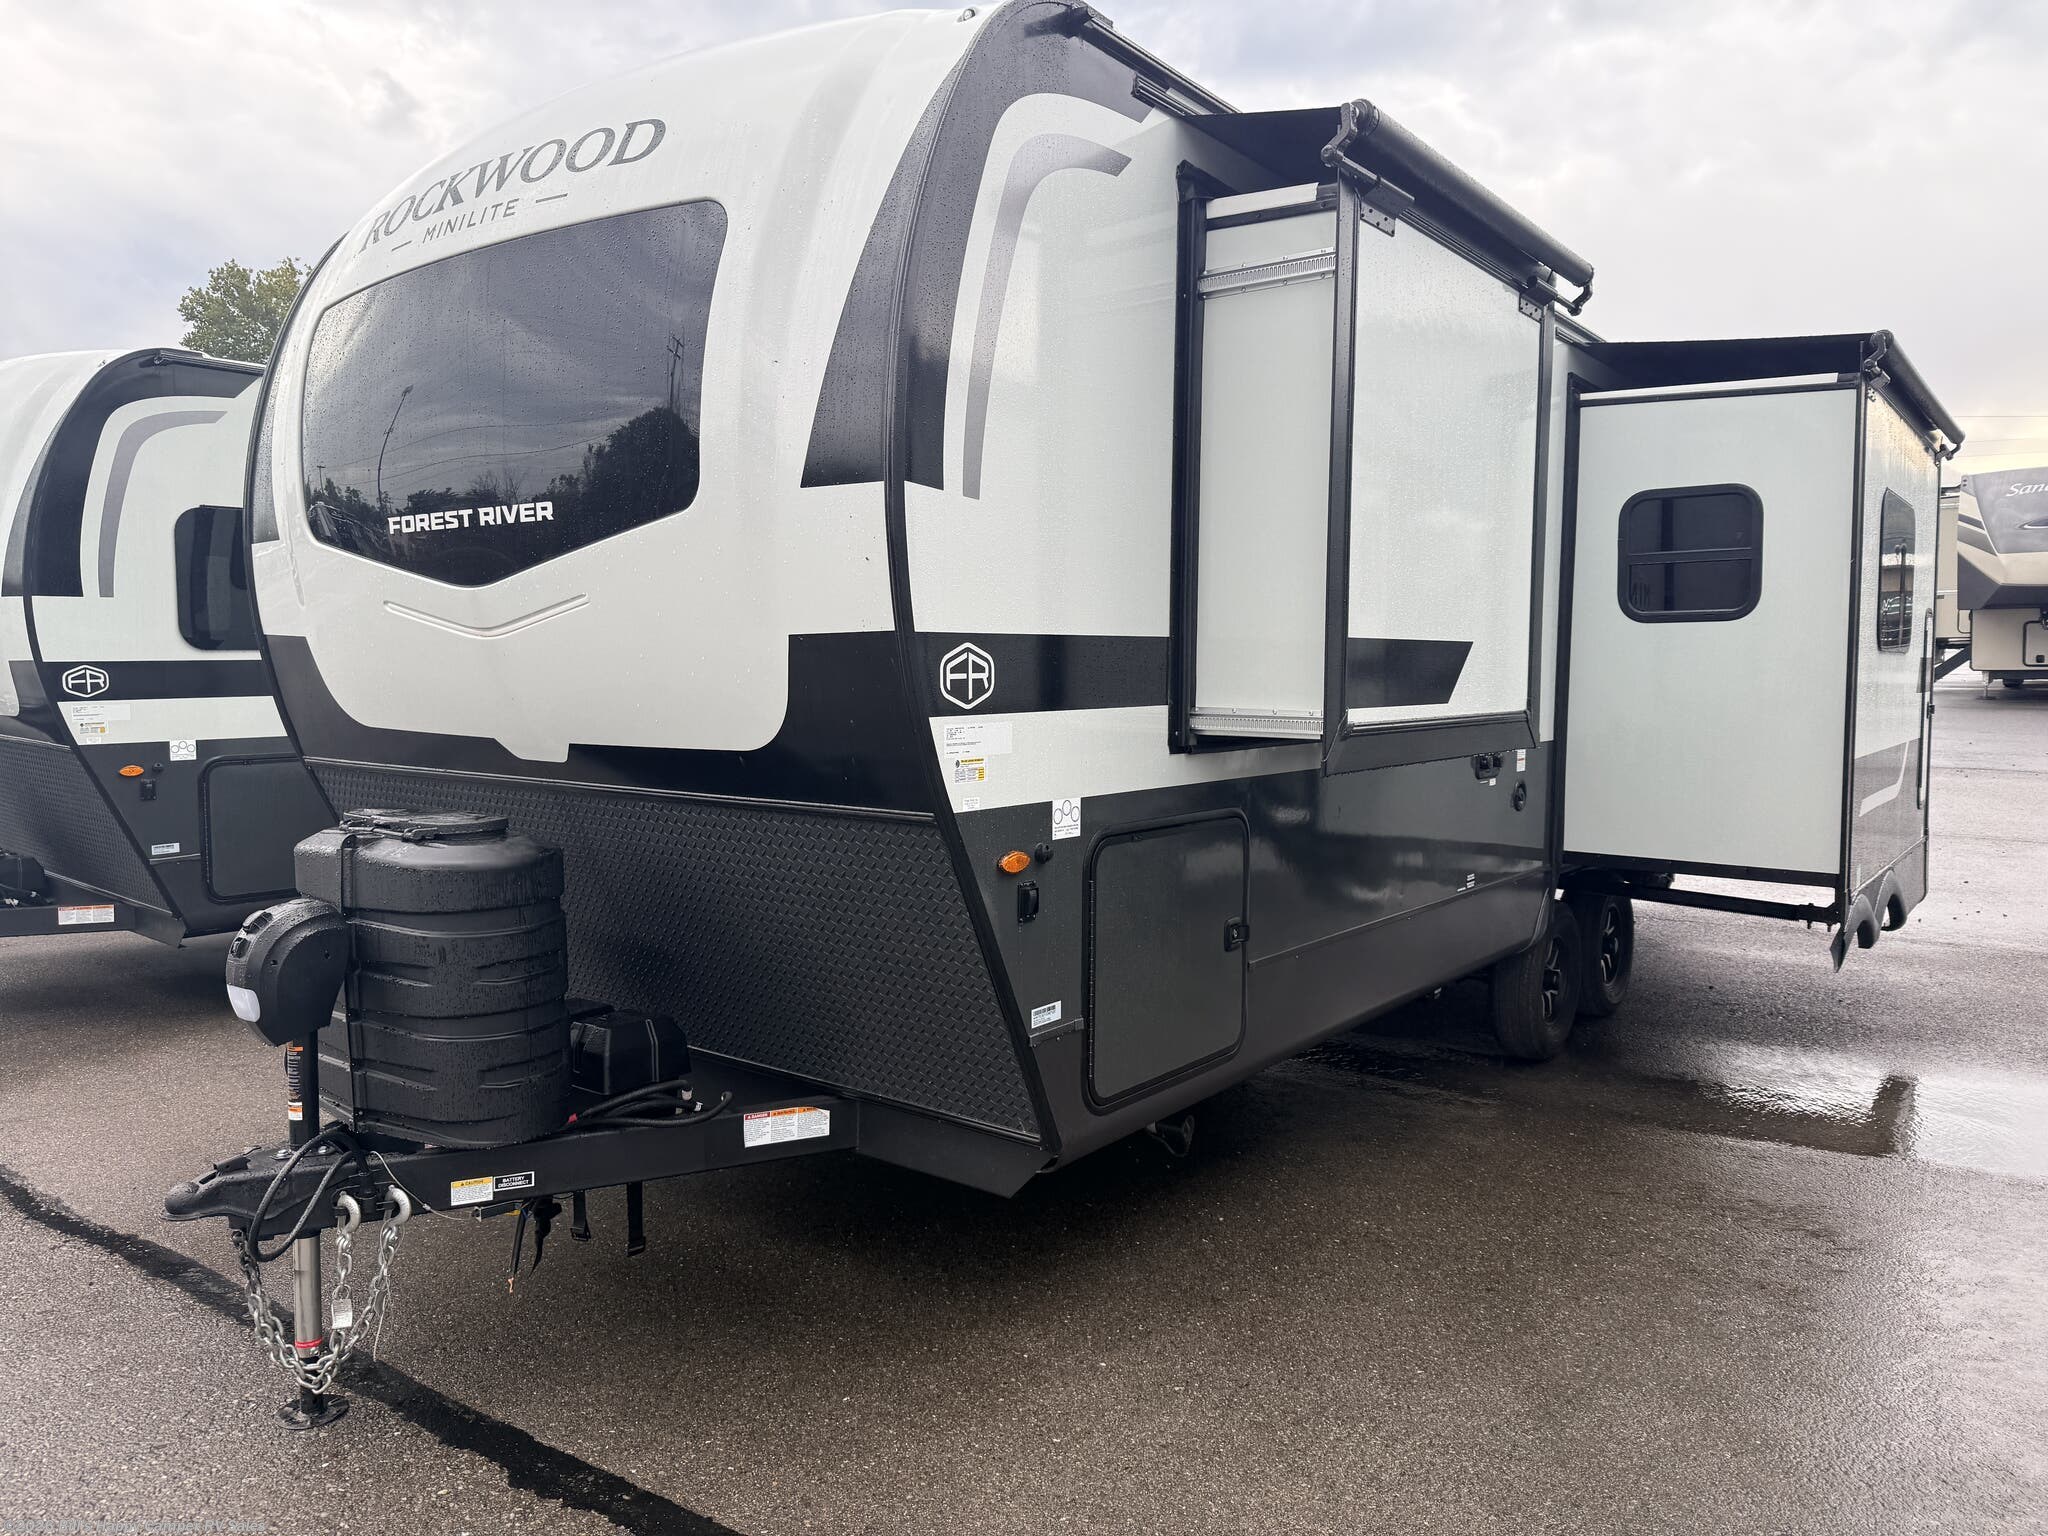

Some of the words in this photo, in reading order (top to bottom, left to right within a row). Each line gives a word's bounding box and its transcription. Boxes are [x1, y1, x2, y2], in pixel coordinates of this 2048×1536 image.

[358, 118, 667, 254] ROCKWOOD
[422, 198, 520, 243] MINILITE
[387, 508, 473, 535] FOREST
[477, 501, 554, 527] RIVER
[498, 1179, 529, 1188] DISCONNECT
[502, 1175, 525, 1183] BATTERY
